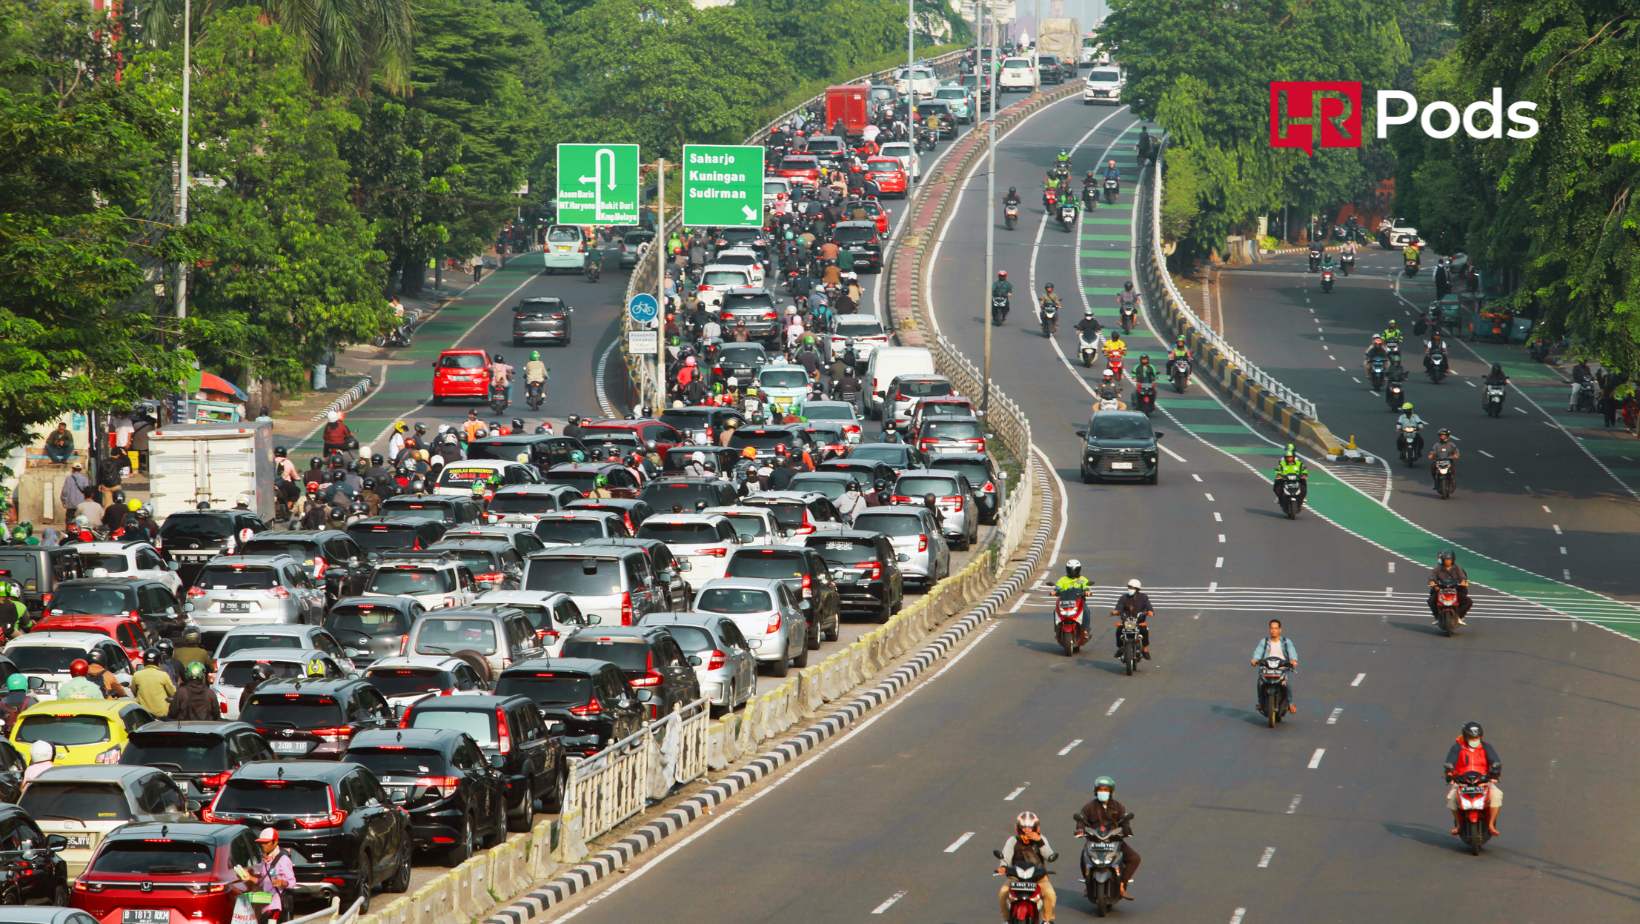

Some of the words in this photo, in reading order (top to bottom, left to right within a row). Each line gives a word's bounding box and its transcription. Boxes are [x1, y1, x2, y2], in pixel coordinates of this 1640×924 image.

[690, 153, 735, 165] Saharjo
[690, 170, 745, 184] Kuningan
[690, 187, 746, 198] Sudirman
